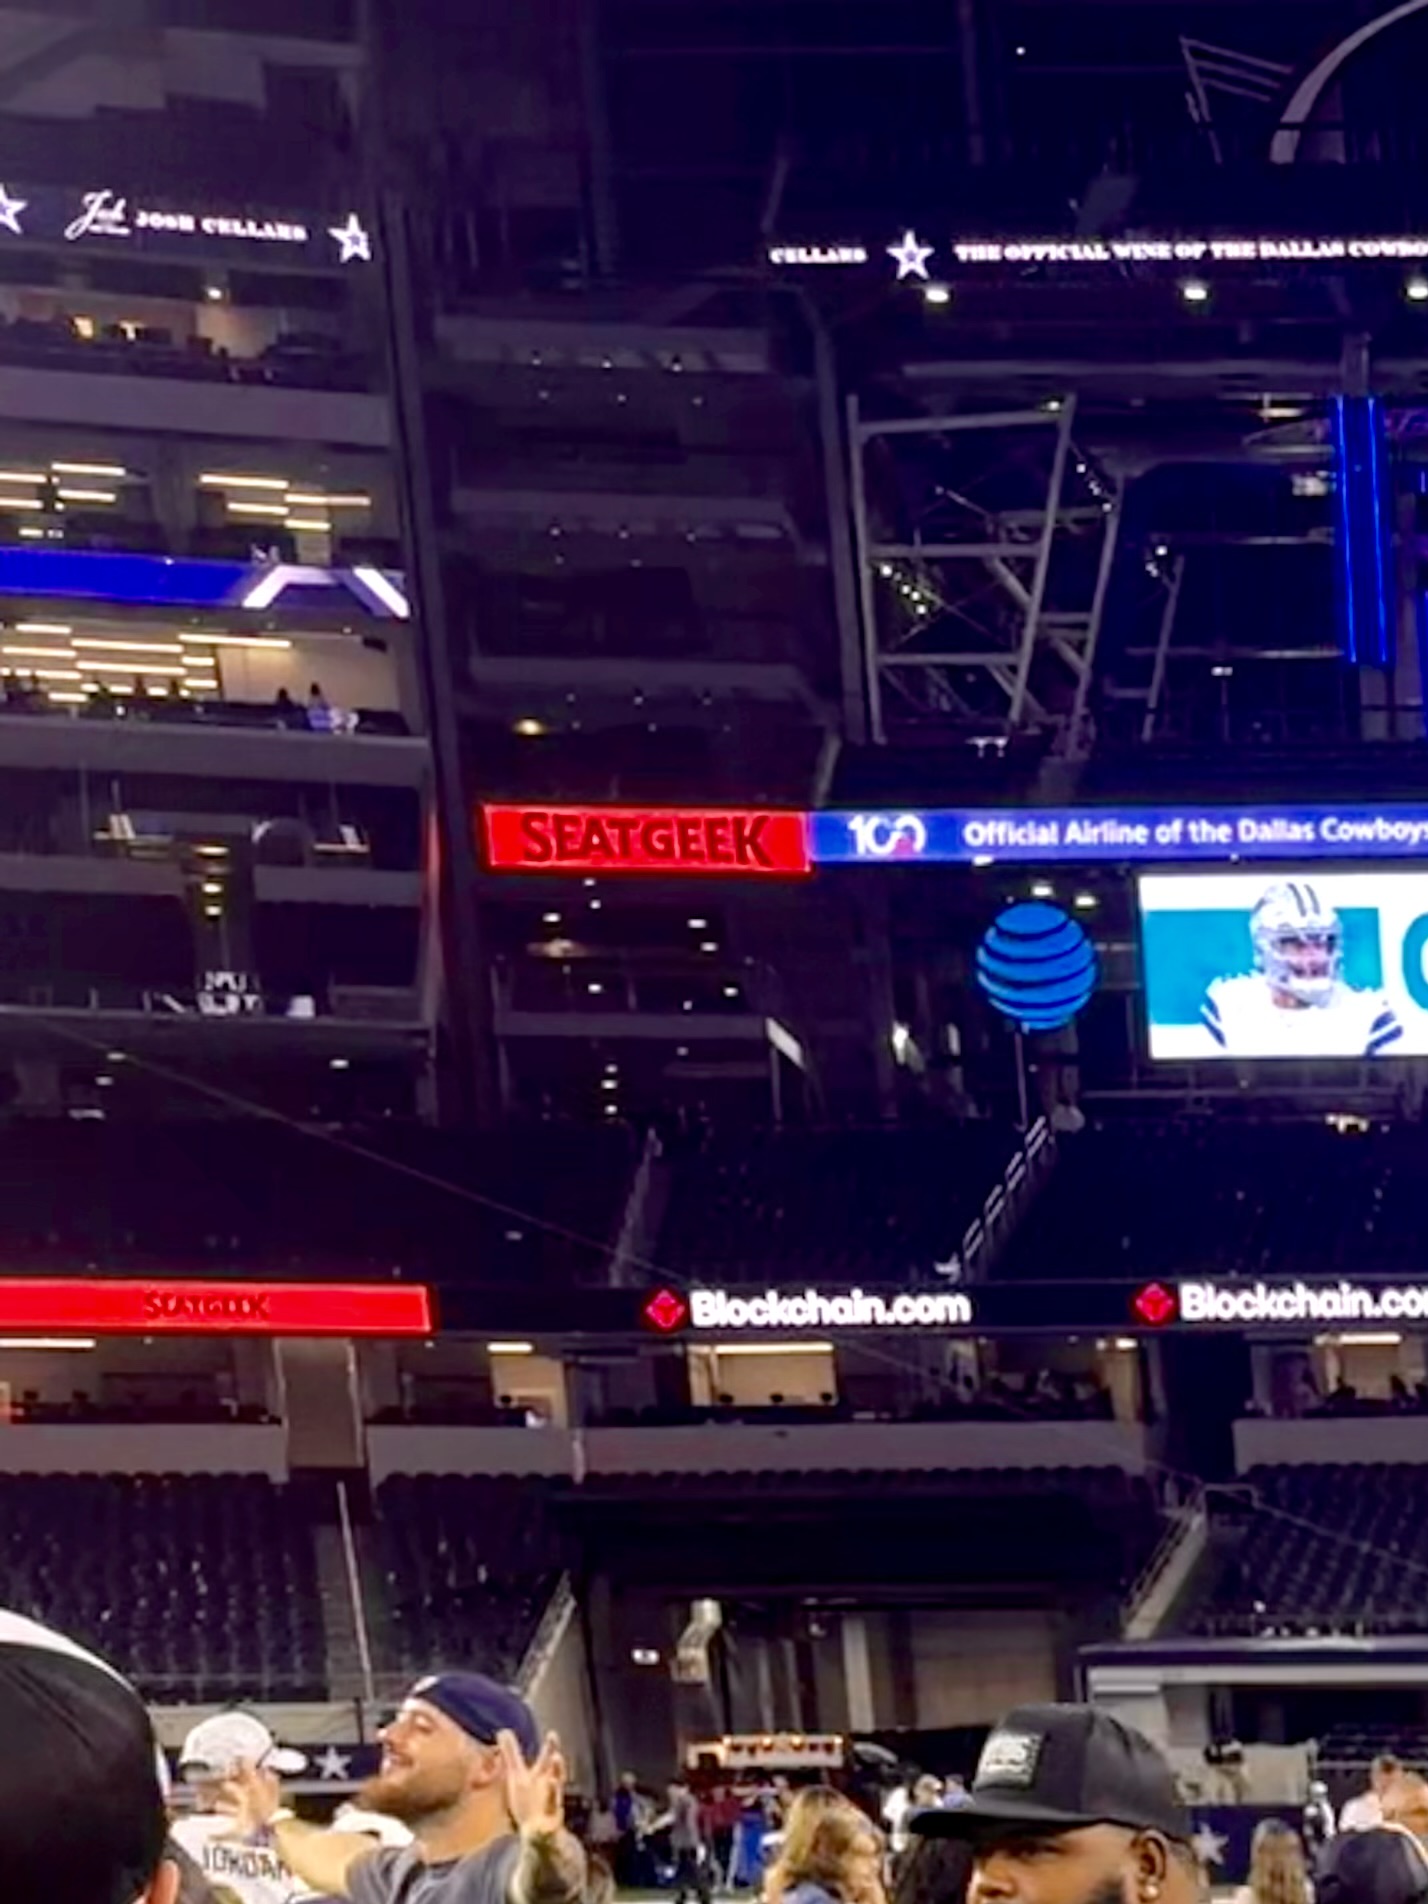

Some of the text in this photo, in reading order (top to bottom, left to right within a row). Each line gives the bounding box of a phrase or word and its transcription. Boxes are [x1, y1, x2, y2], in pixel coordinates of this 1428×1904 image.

[136, 211, 196, 232] JOSH
[201, 217, 308, 241] CELLARS
[768, 247, 868, 264] CELLARS
[954, 244, 1002, 261] THE
[1003, 243, 1110, 261] OFFICIAL
[1174, 242, 1206, 260] OF
[1210, 241, 1256, 260] THE
[519, 811, 775, 868] SEATGEEK
[962, 820, 1060, 846] Official
[1064, 819, 1149, 845] Airline
[1156, 818, 1184, 845] of
[1187, 818, 1231, 843] the
[1237, 818, 1315, 844] Dallas
[690, 1288, 972, 1327] Blockchain.com
